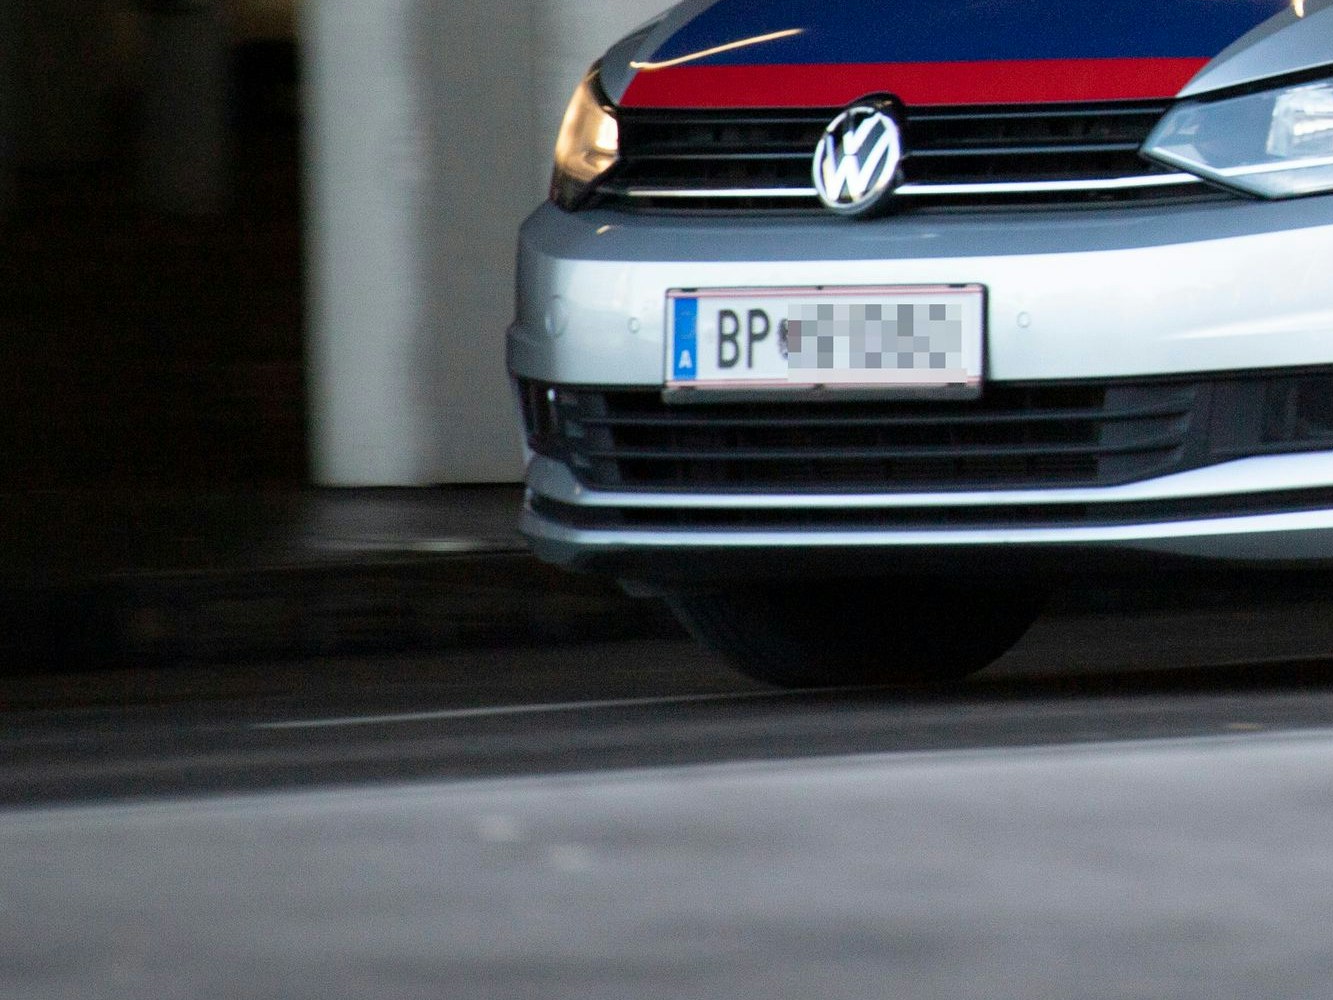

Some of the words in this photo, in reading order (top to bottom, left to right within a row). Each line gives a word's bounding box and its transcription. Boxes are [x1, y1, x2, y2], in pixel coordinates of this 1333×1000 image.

[815, 106, 901, 211] VW
[678, 349, 693, 369] A
[718, 308, 770, 369] BP
